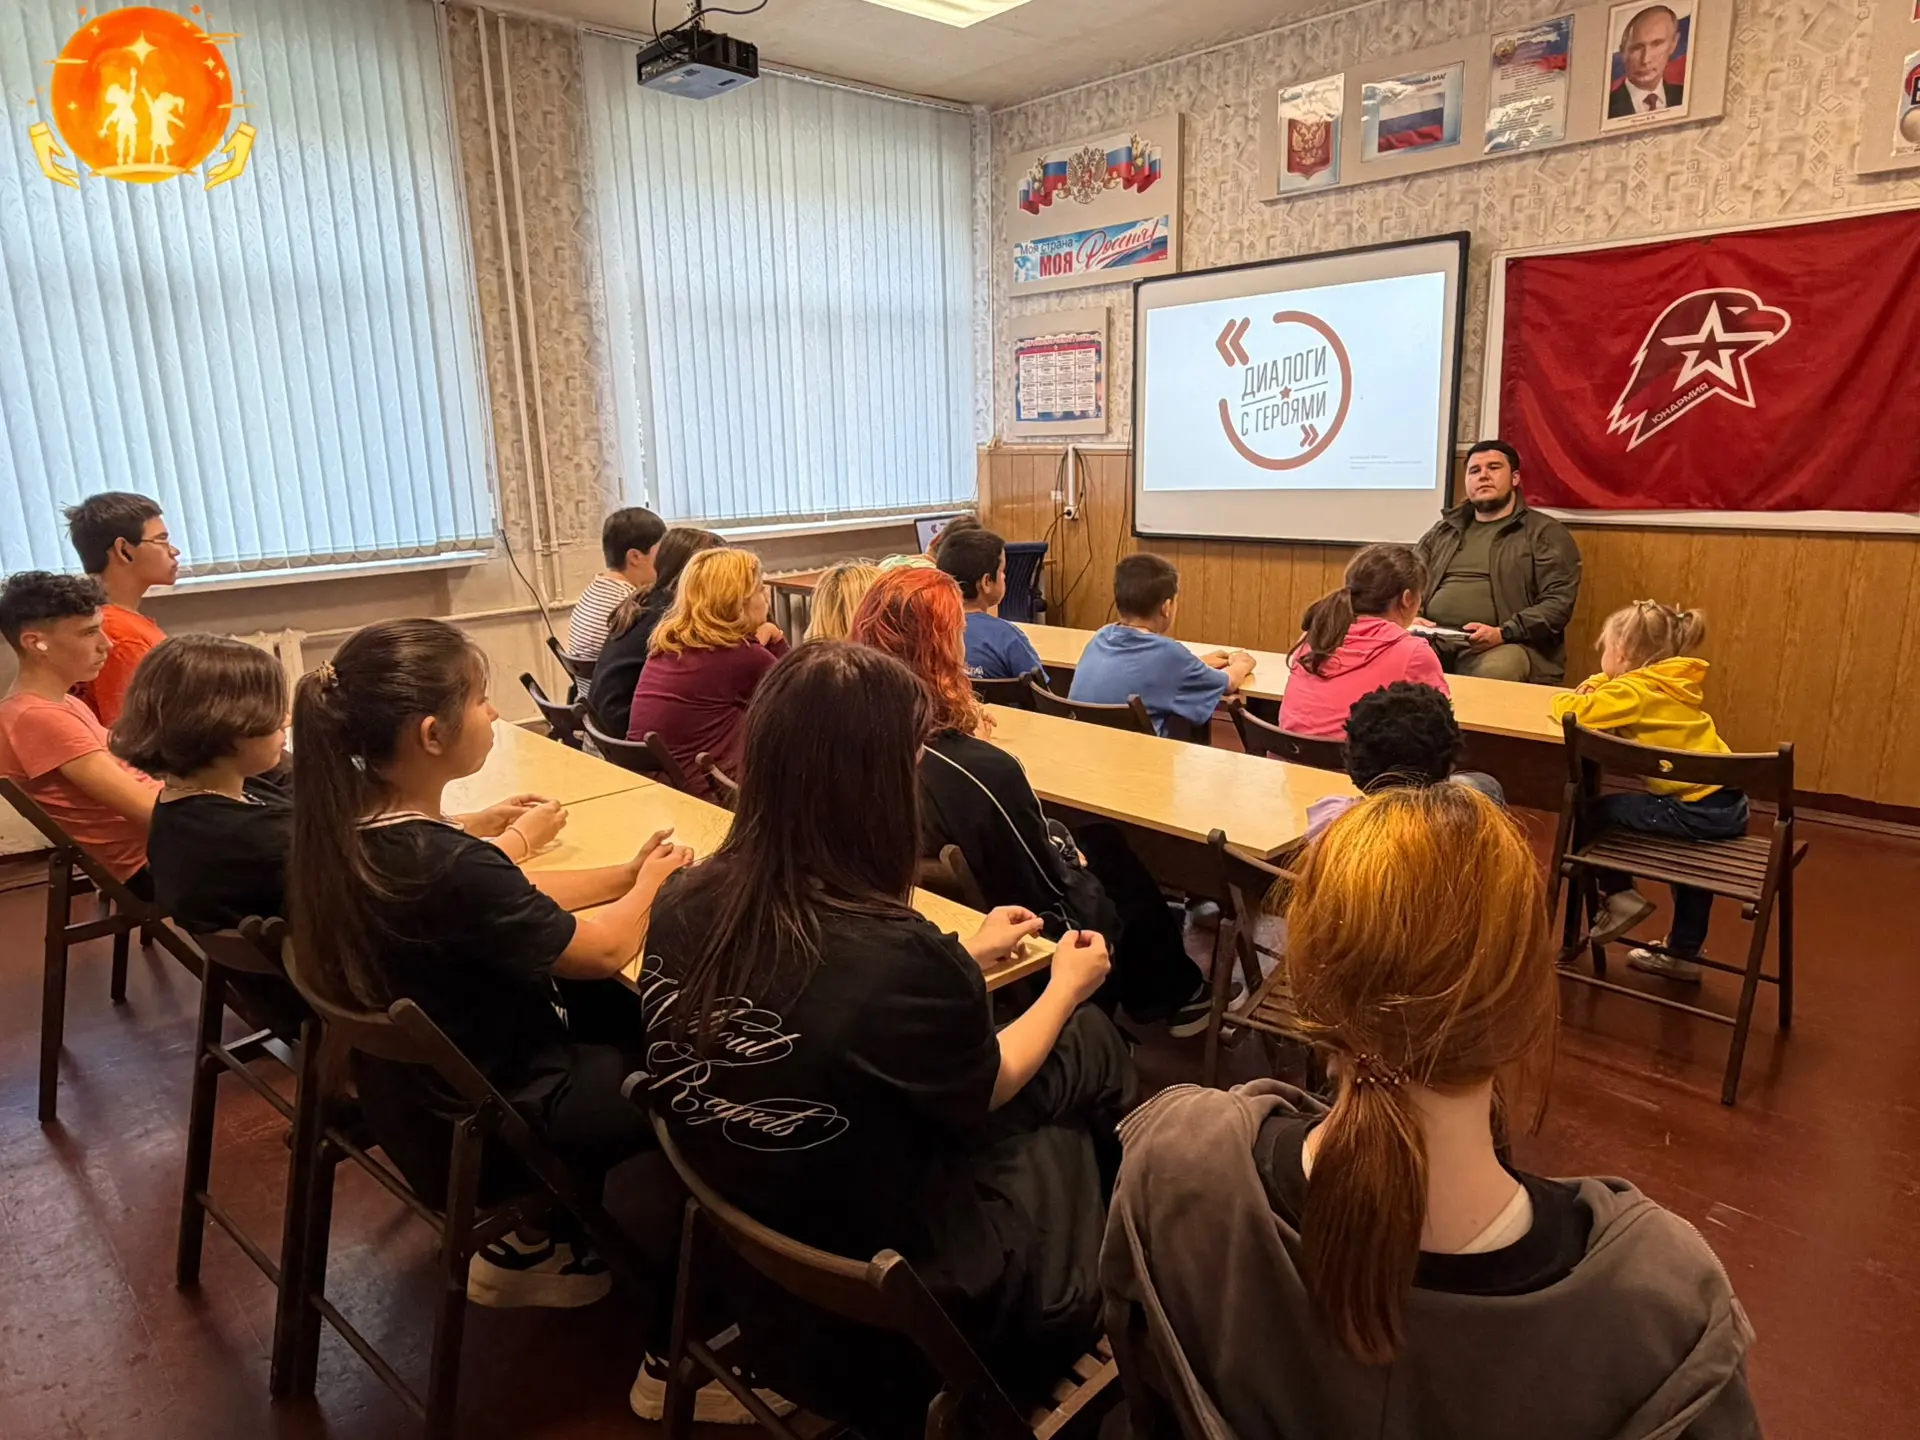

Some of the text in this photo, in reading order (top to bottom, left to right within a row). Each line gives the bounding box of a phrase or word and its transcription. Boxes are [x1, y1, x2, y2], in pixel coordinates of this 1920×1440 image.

[1021, 244, 1039, 255] Моя
[1040, 239, 1073, 254] страна
[1040, 219, 1159, 277] МОЯ Россия!
[1241, 345, 1327, 400] ДИАЛОГИ
[1241, 391, 1327, 436] С ГЕРОЯМИ
[1652, 384, 1708, 423] ЮНАРМИЯ
